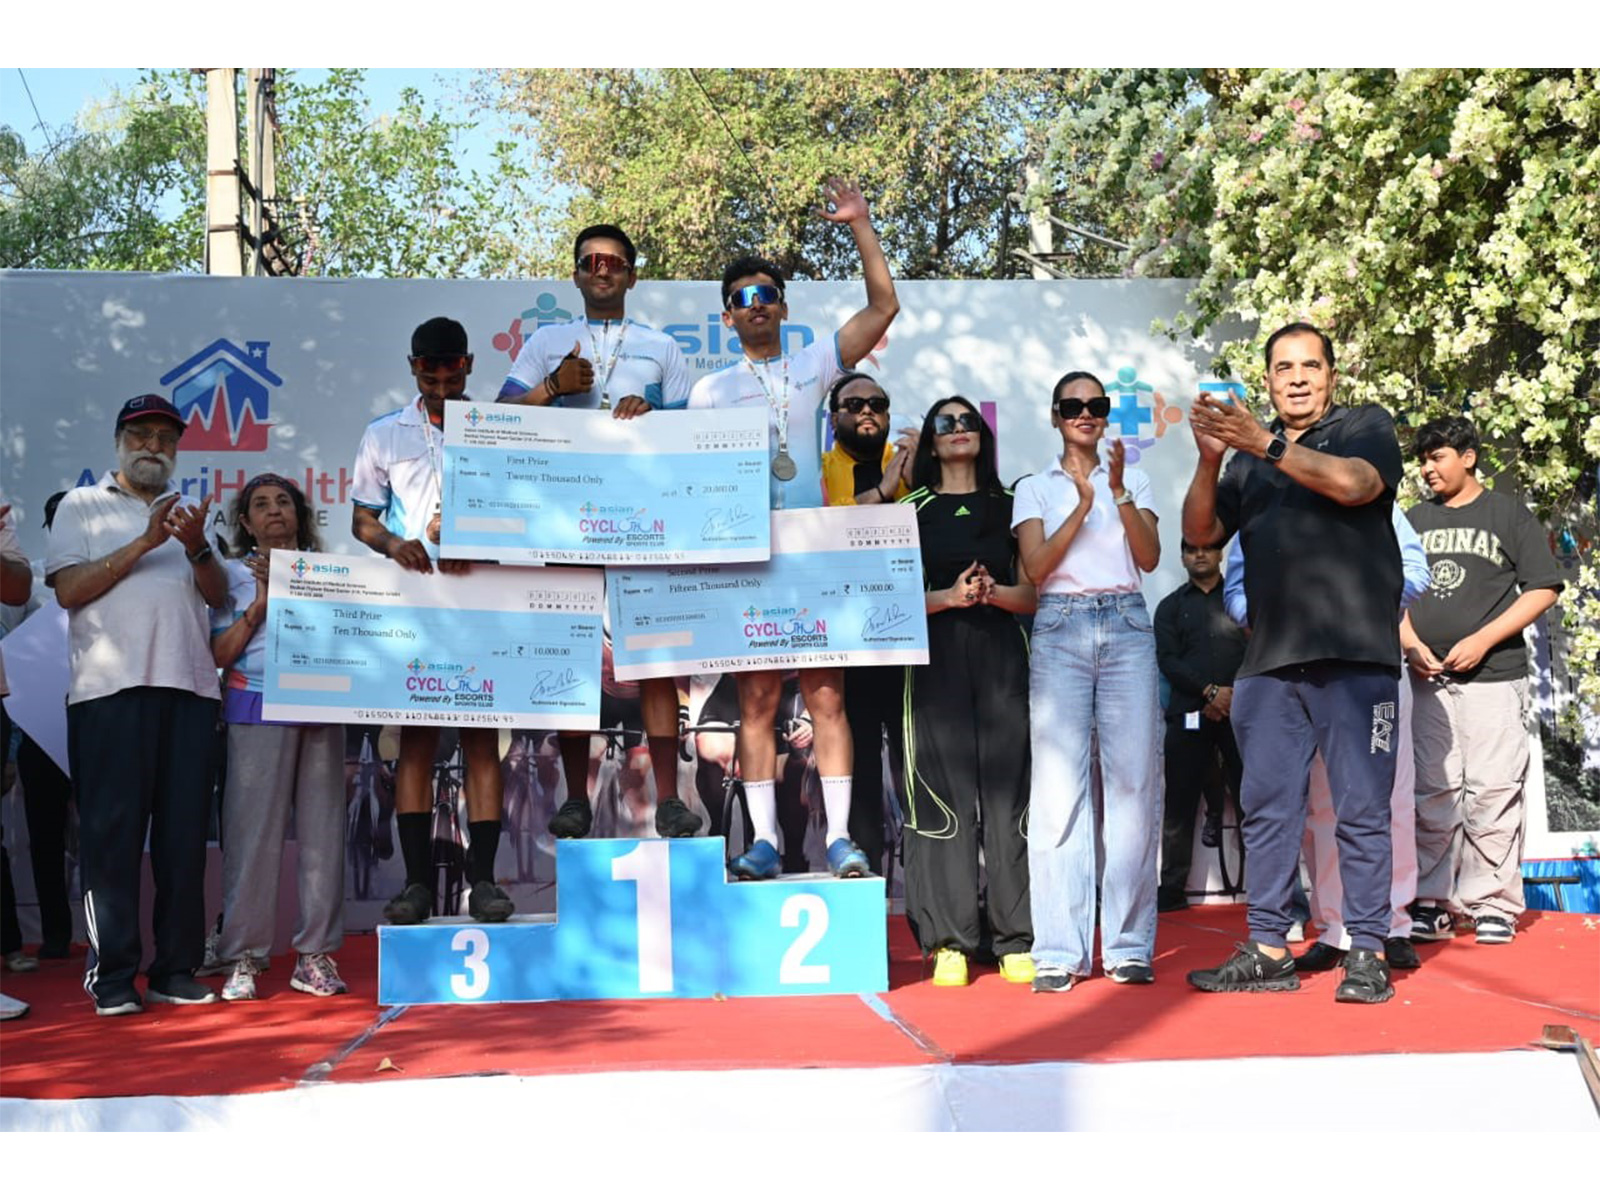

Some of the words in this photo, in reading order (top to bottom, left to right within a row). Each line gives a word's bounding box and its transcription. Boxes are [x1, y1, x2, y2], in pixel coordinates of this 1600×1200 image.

[485, 413, 522, 424] asian
[506, 455, 526, 466] First
[527, 457, 549, 466] Prize
[506, 471, 538, 483] Twenty
[541, 473, 581, 483] Thousand
[582, 475, 604, 486] Only
[599, 504, 634, 513] asian
[582, 536, 613, 544] Powered
[613, 536, 626, 546] By
[626, 533, 665, 541] ESCORTS
[1421, 527, 1503, 567] IGINAL
[312, 563, 350, 574] asian
[669, 583, 699, 594] Fifteen
[700, 578, 740, 590] Thousand
[740, 577, 763, 589] Only
[332, 608, 357, 619] Third
[359, 610, 382, 620] Prize
[762, 606, 797, 617] asian
[332, 625, 350, 636] Ten
[352, 627, 393, 638] Thousand
[395, 629, 417, 640] Only
[748, 638, 780, 648] Powered
[779, 637, 790, 649] By
[790, 634, 829, 643] ESCORTS
[427, 661, 463, 671] asian
[409, 694, 440, 703] Powered
[440, 695, 453, 705] By
[454, 693, 495, 702] ESCORTS
[610, 840, 675, 993] 1
[779, 893, 831, 984] 2
[450, 928, 490, 999] 3
